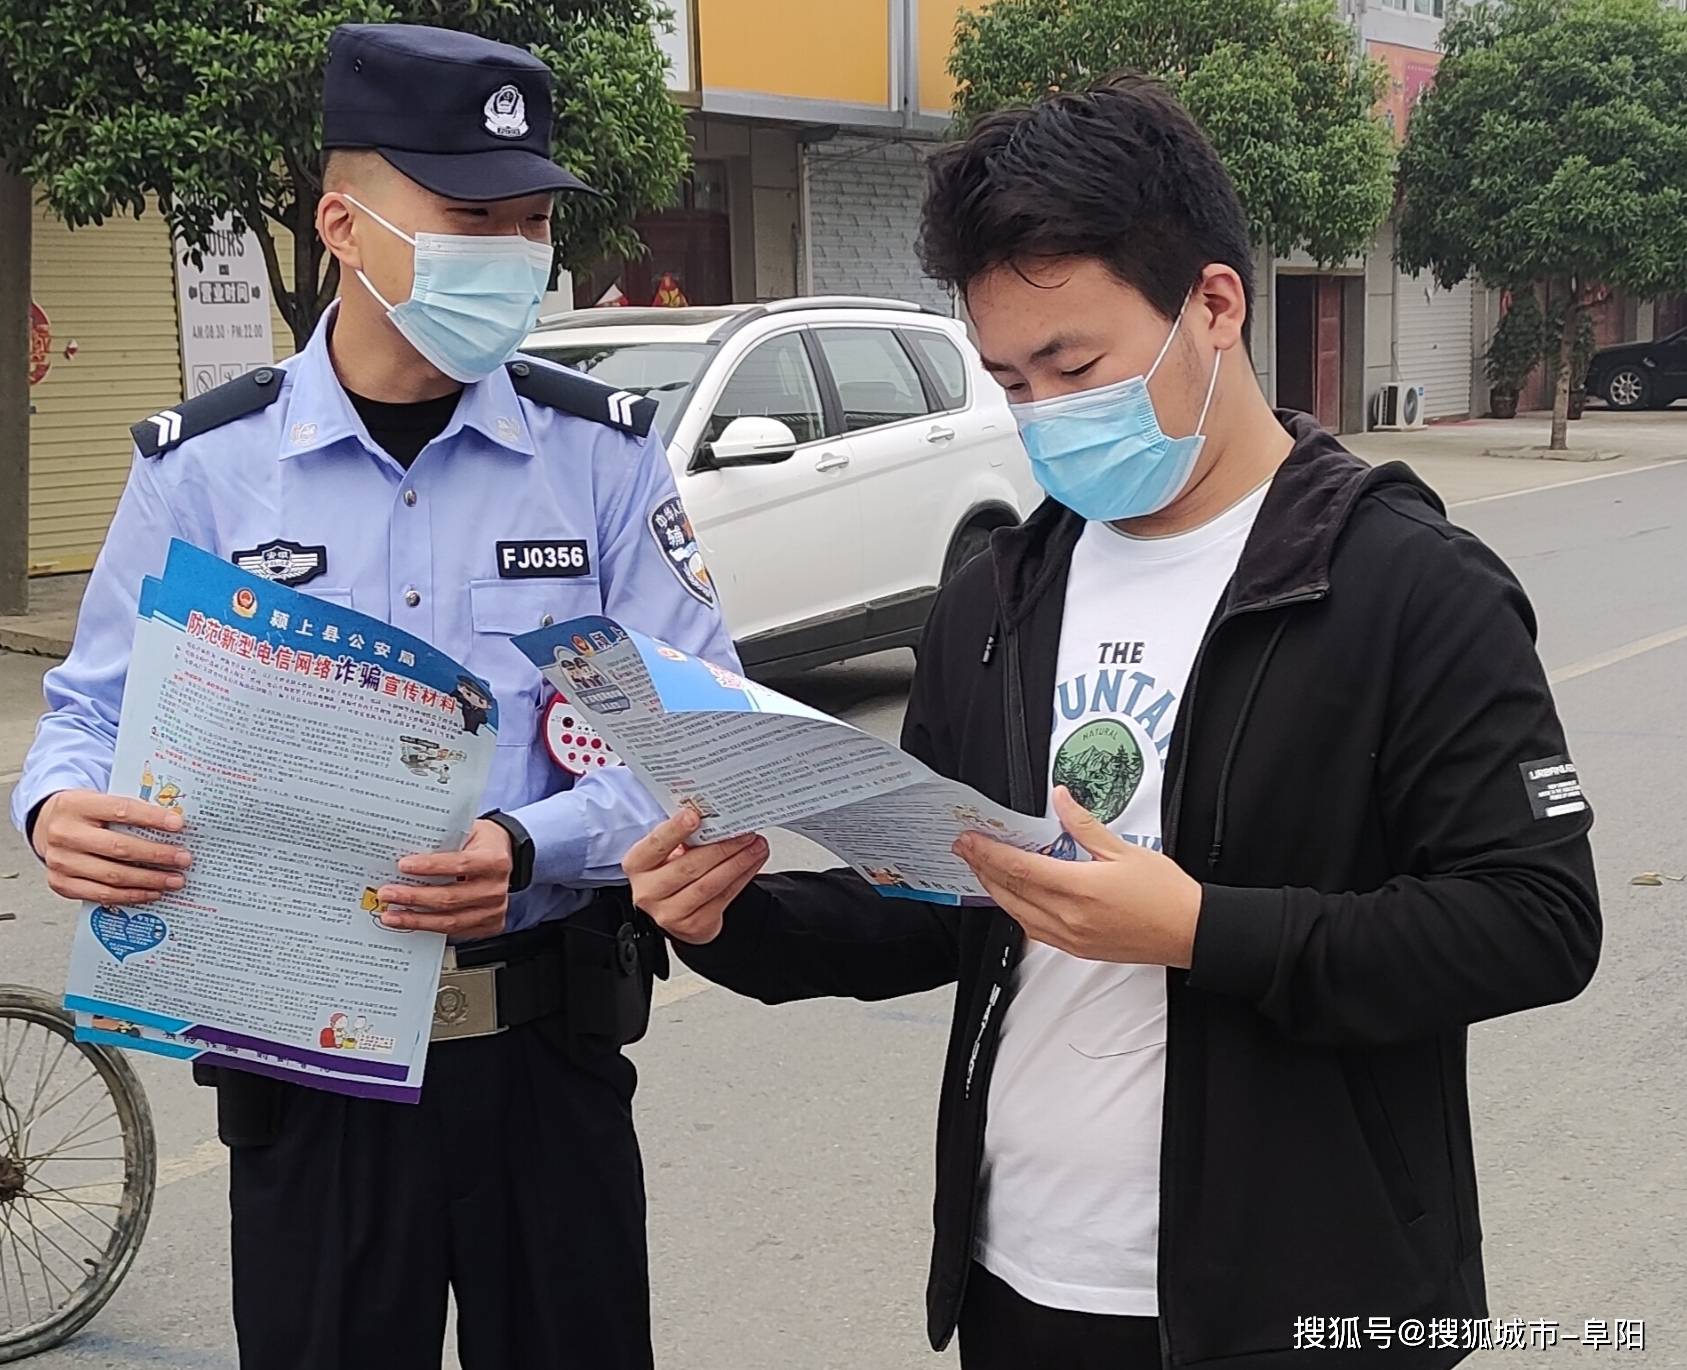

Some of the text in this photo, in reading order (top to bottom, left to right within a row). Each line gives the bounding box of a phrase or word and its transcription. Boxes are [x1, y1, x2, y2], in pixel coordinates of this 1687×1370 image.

[206, 230, 245, 257] OURS
[502, 546, 584, 570] FJ0356
[187, 611, 457, 713] 防范新型电信网络诈骗宣传材料
[1098, 641, 1145, 664] THE
[1051, 669, 1176, 754] UNTA
[1082, 727, 1119, 741] NATURAL
